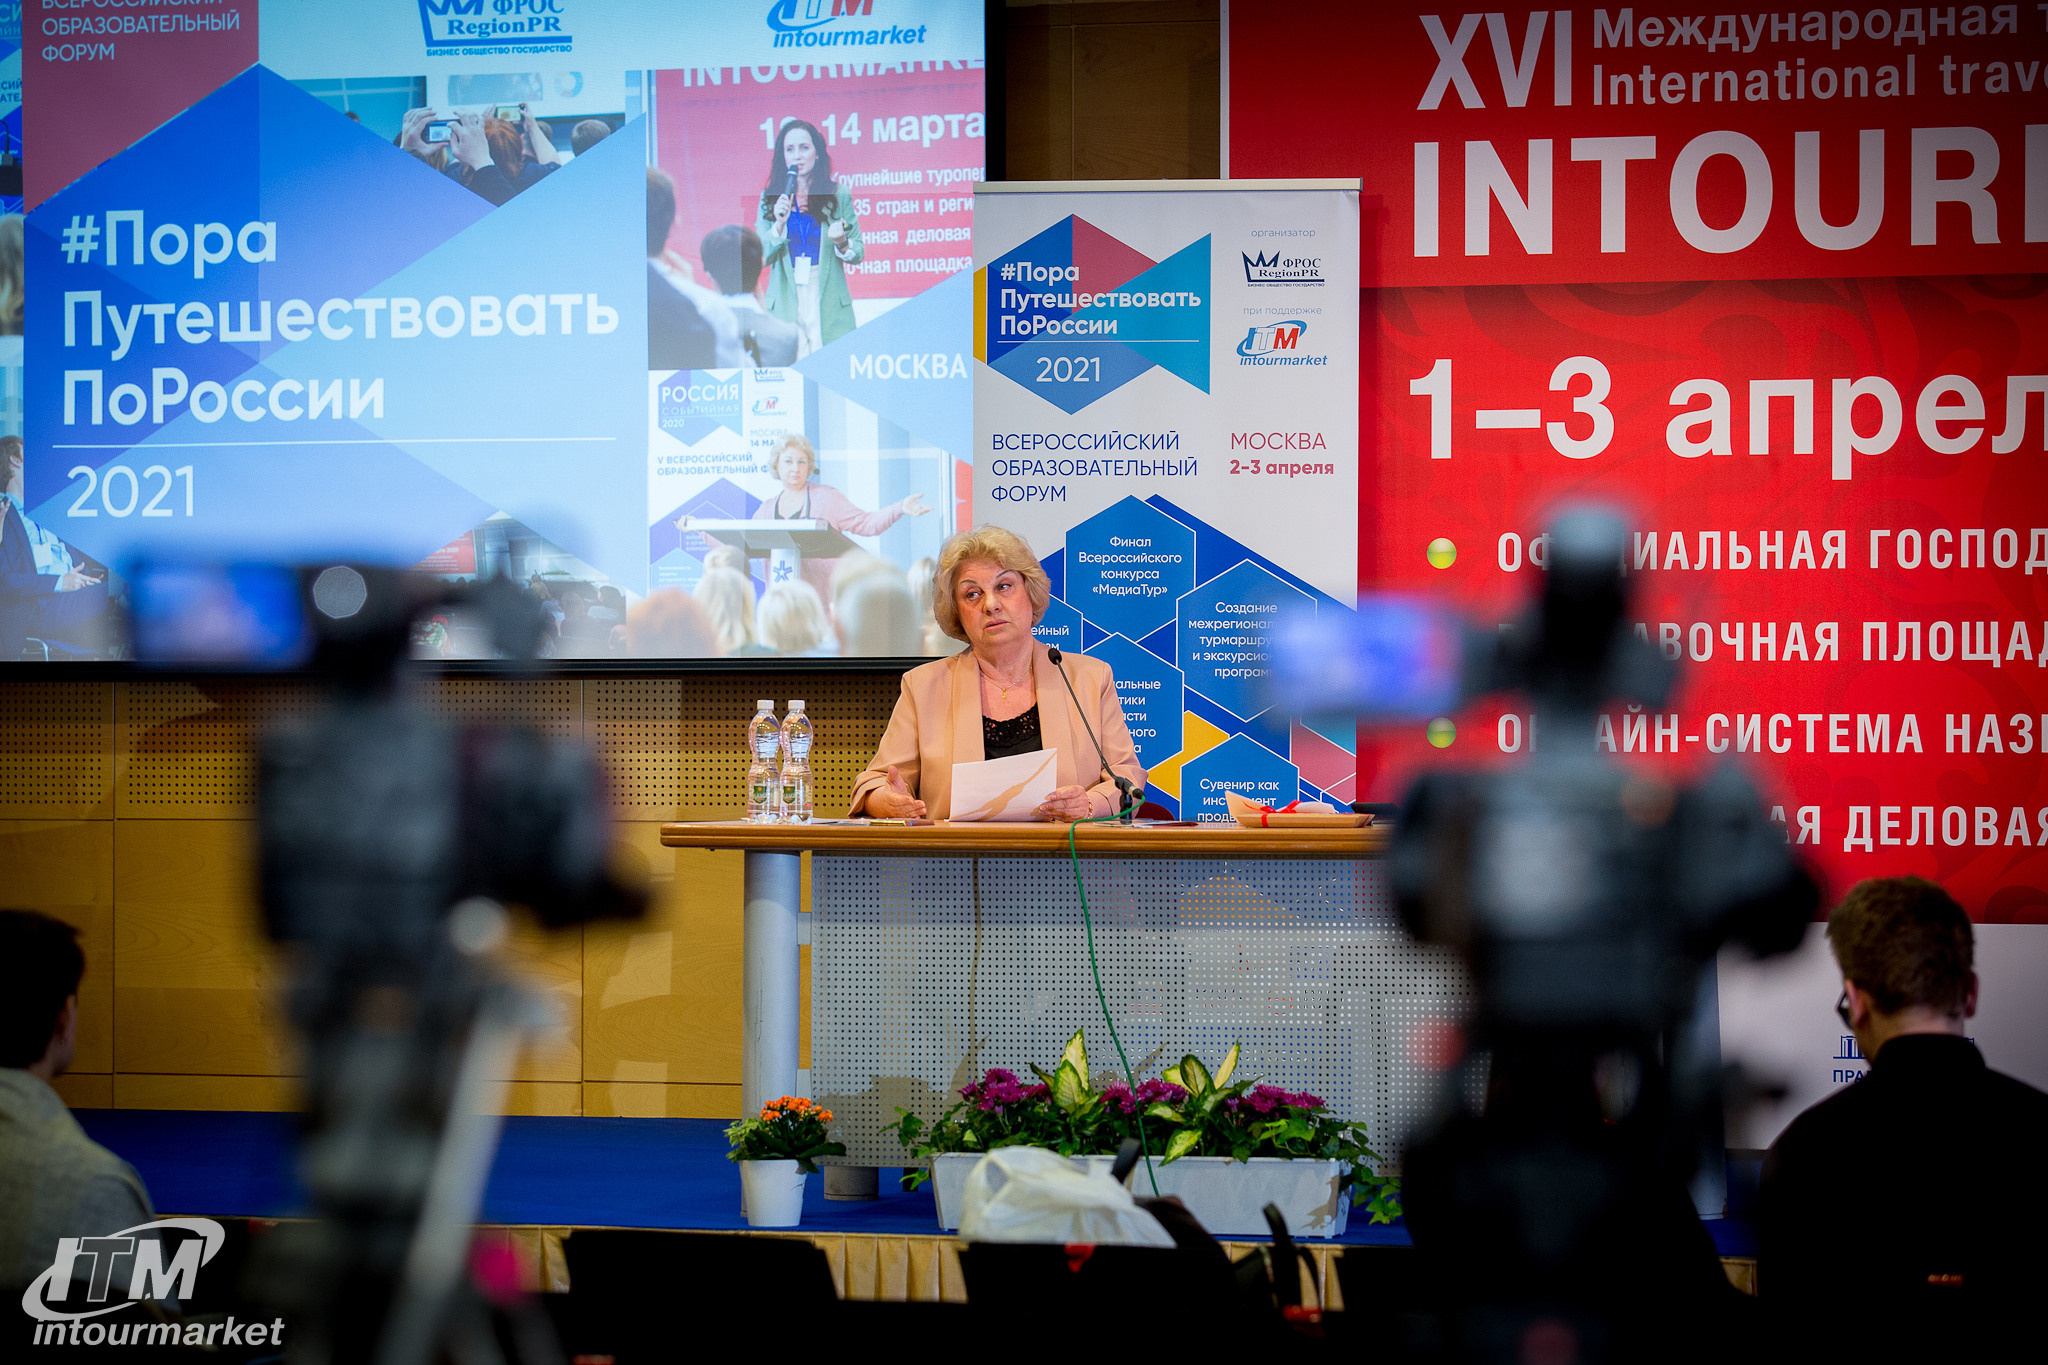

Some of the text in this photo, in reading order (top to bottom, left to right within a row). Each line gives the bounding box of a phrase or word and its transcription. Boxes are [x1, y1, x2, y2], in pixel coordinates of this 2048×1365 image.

[42, 9, 240, 35] ОБРАЗОВАТЕЛЬНЫЙ
[447, 16, 562, 38] RegionPR
[1594, 4, 2019, 53] Международная
[773, 24, 927, 48] intourmarket
[42, 43, 115, 62] ФОРУМ
[426, 45, 573, 57] БИЗНЕС ОБЩЕСТВО ГОСУДАРСТВО
[1417, 10, 1572, 111] XVI
[1594, 54, 2048, 106] International trav
[872, 112, 985, 148] марта
[1414, 124, 2048, 257] INTOUR
[853, 198, 872, 216] 35
[876, 198, 920, 218] стран
[924, 199, 935, 213] и
[60, 209, 277, 279] #Пора
[905, 227, 971, 246] деловая
[1251, 230, 1316, 238] организатор
[844, 255, 973, 275] очная площадка
[1283, 258, 1321, 268] ФРОС
[1000, 262, 1079, 285] #Пора
[1259, 270, 1319, 278] RegionPR
[1001, 288, 1201, 311] Путешествовать
[1243, 307, 1322, 315] при поддержке
[64, 290, 619, 361] Путешествовать
[1000, 315, 1117, 335] ПоРоссии
[1245, 327, 1300, 350] ITM
[850, 353, 968, 379] МОСКВА
[1036, 356, 1101, 382] 2021
[1240, 355, 1328, 366] intourmarket
[63, 366, 385, 425] ПоРоссии
[662, 384, 739, 403] РОССИЯ
[662, 419, 685, 428] 2020
[1665, 374, 2048, 480] апрел
[992, 430, 1180, 451] ВСЕРОССИЙСКИЙ
[1231, 432, 1327, 450] МОСКВА
[666, 452, 753, 464] ВСЕРОССИЙСКИЙ
[992, 456, 1199, 476] ОБРАЗОВАТЕЛЬНЫЙ
[657, 464, 758, 476] ОБРАЗОВАТЕЛЬНЫЙ
[1266, 462, 1335, 479] апреля
[66, 464, 195, 518] 2021
[991, 485, 1067, 502] ФОРУМ
[1110, 535, 1152, 548] Финал
[1078, 551, 1183, 565] Всероссийского
[1869, 528, 2048, 576] ГОСПОД
[1101, 569, 1160, 582] конкурса
[1092, 584, 1168, 598] «МедиаТур»
[1215, 602, 1278, 615] Создание
[1192, 652, 1271, 663] и экскурсио
[1113, 680, 1161, 689] альные
[1945, 713, 2048, 754] НАЗ
[1200, 778, 1280, 792] Сувенир как
